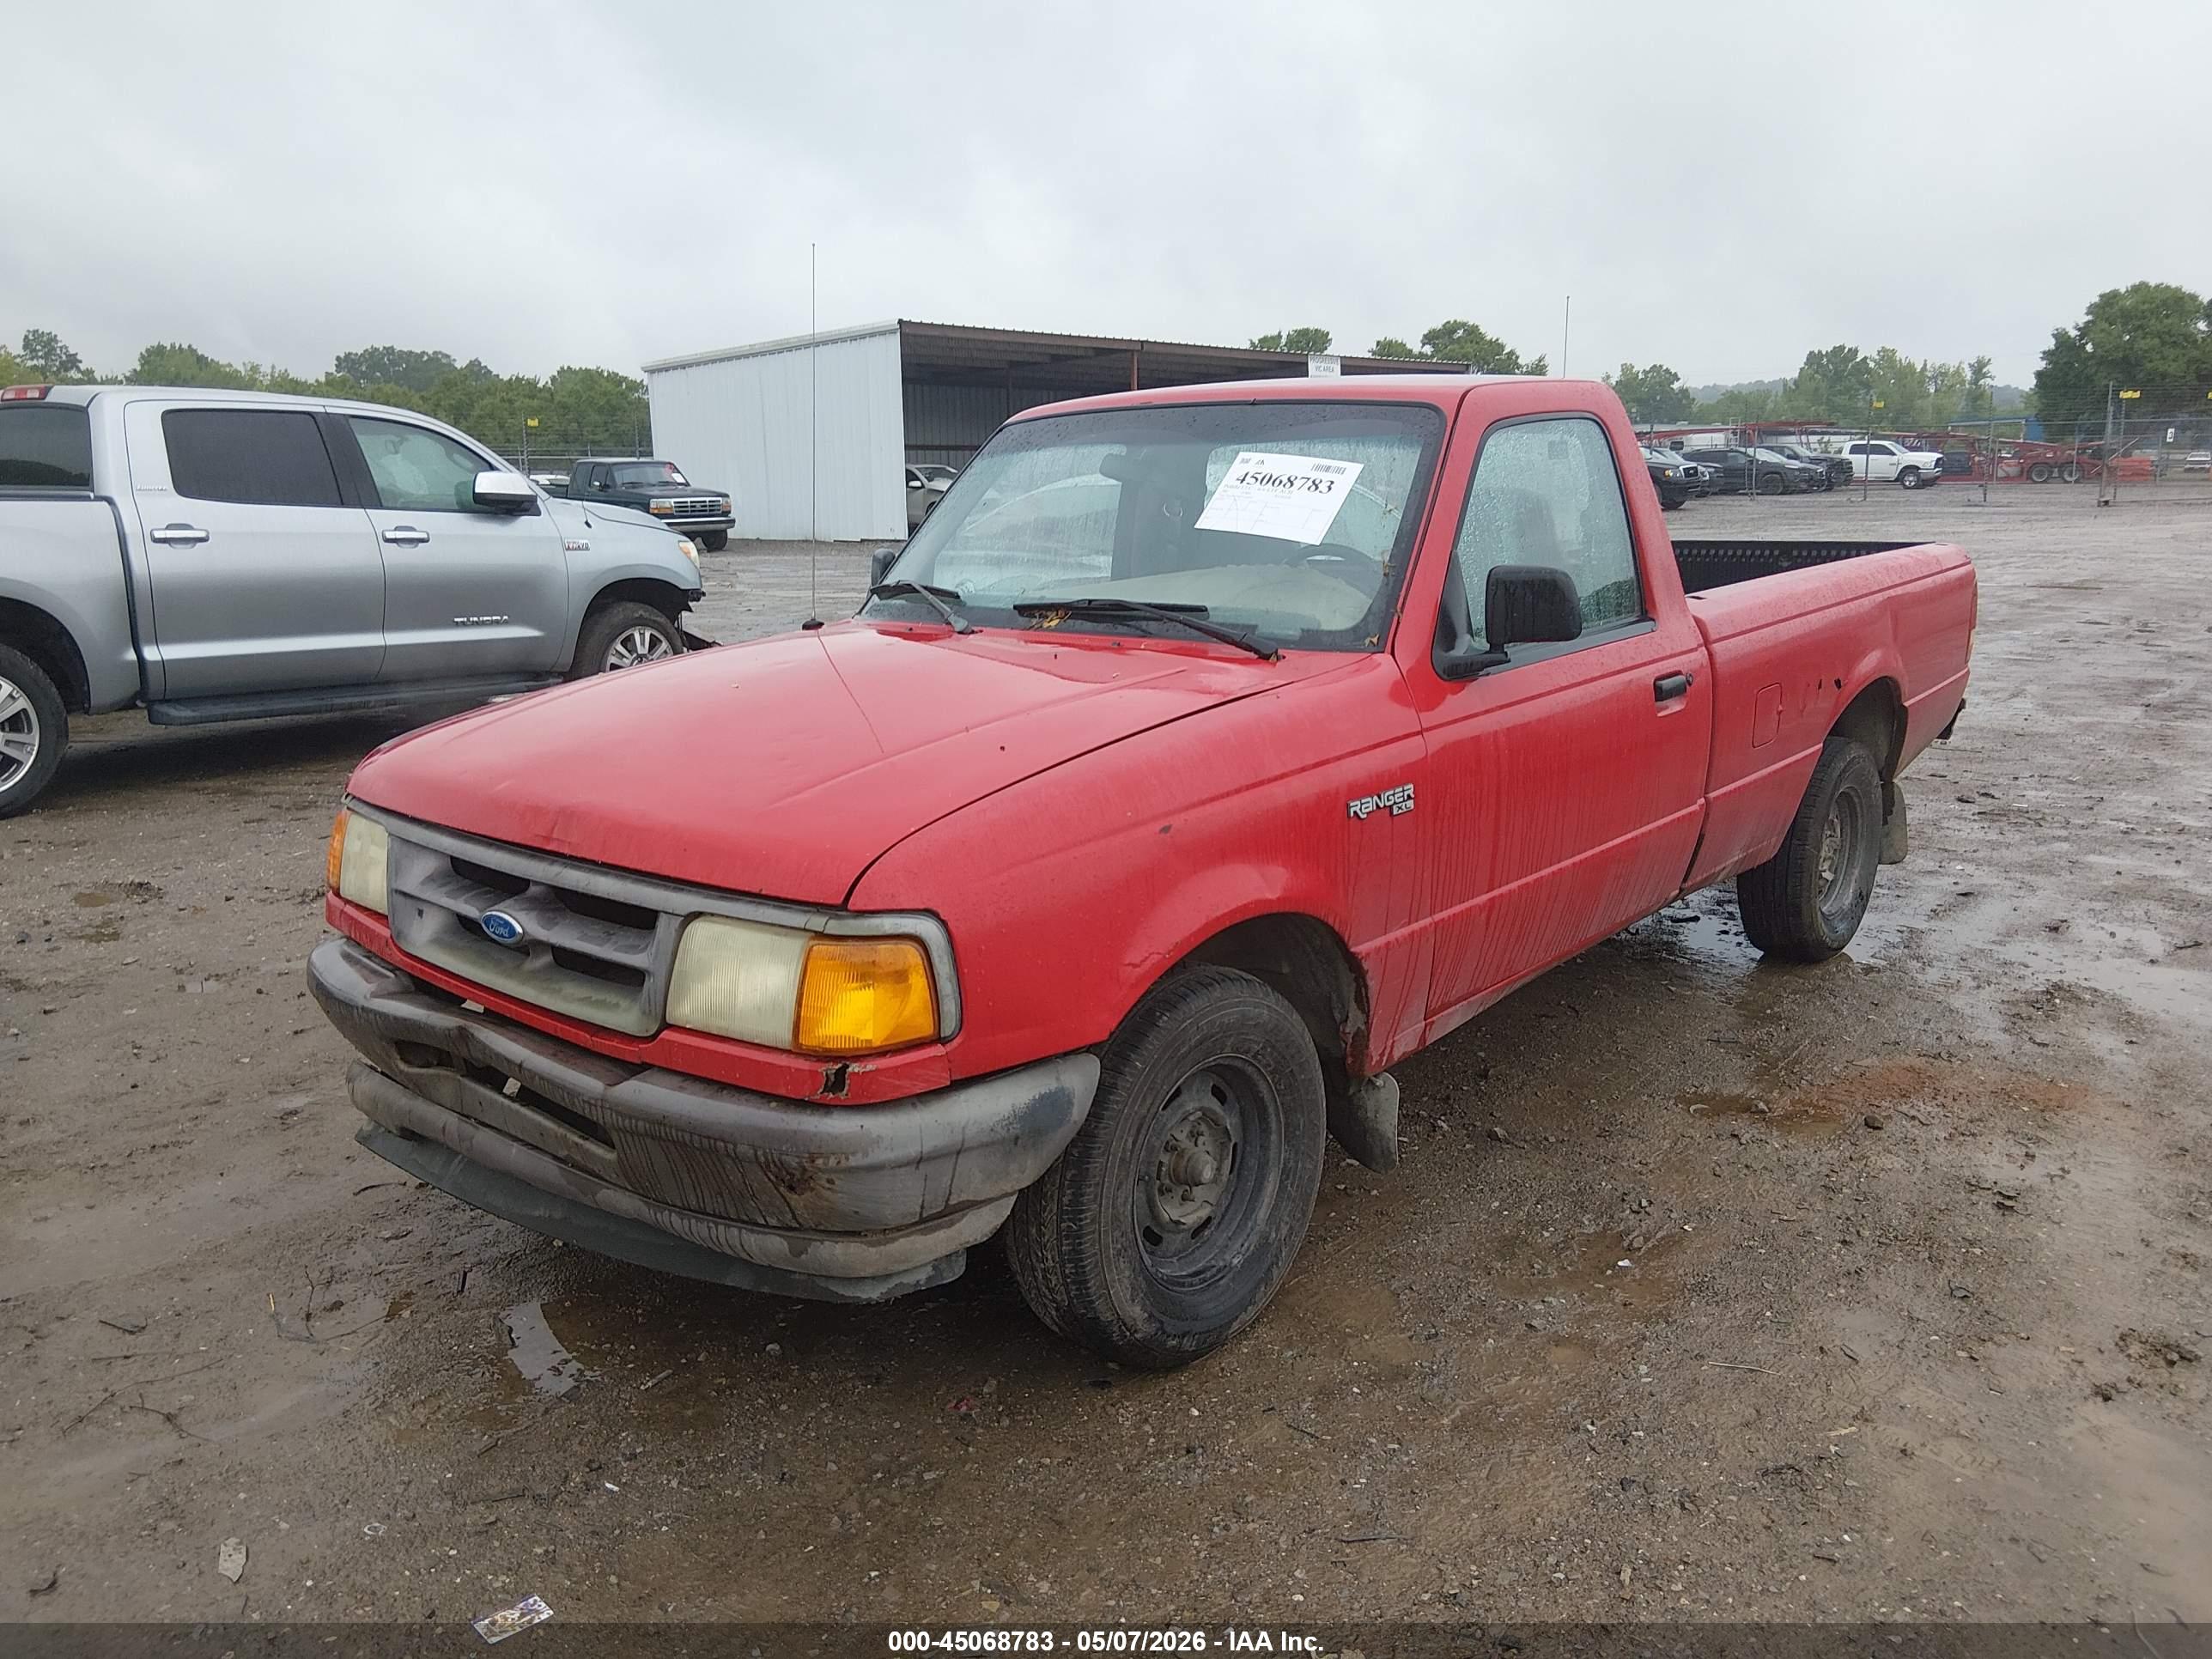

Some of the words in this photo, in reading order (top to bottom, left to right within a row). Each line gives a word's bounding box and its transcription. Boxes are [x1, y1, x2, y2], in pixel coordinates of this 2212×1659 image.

[1236, 471, 1335, 495] 45068783
[453, 616, 509, 626] TUNDRA
[1347, 783, 1415, 819] RANGER
[1395, 801, 1413, 814] XL
[488, 916, 512, 938] Ford
